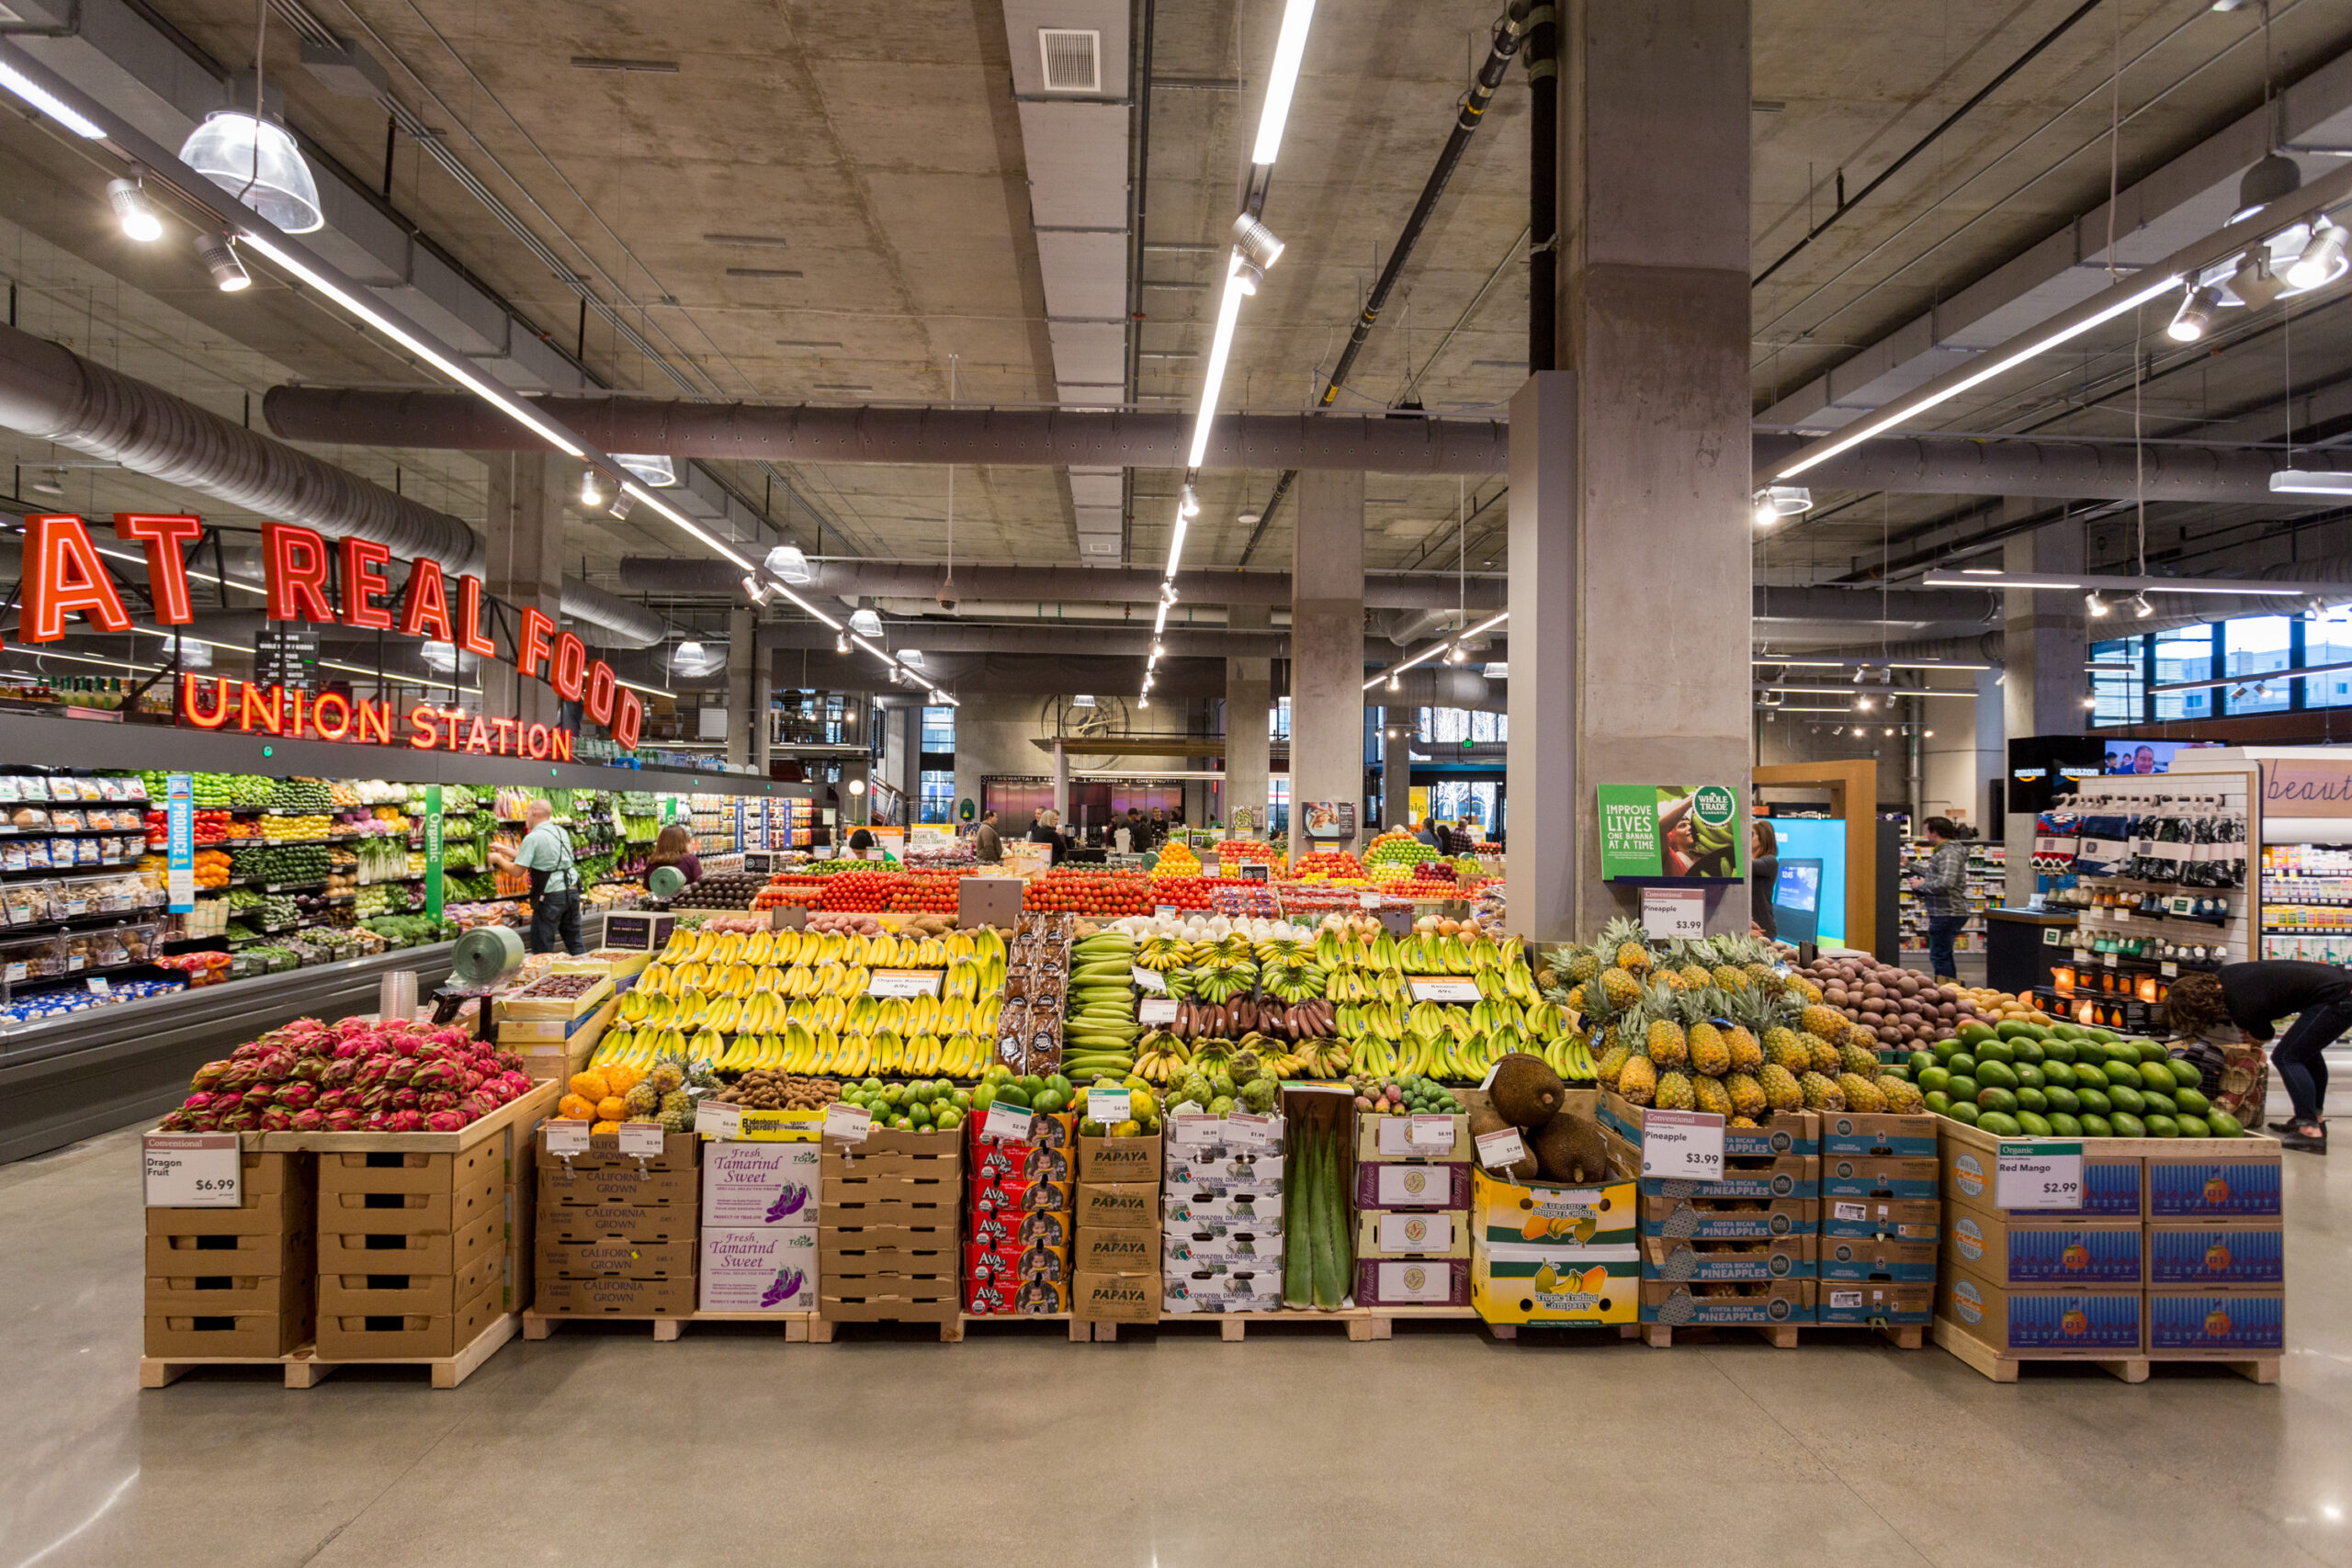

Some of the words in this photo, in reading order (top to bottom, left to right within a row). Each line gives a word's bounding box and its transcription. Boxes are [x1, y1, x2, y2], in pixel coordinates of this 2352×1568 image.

[0, 513, 203, 645] AT
[261, 522, 495, 658] REAL
[518, 606, 641, 750] FOOD
[185, 672, 390, 744] UNION
[411, 705, 571, 761] STATION
[2014, 768, 2046, 777] amazon
[2060, 768, 2099, 777] amazon
[1698, 793, 1727, 804] WHOLE
[1409, 802, 1425, 813] ale
[1606, 805, 1652, 815] IMPROVE
[173, 803, 187, 855] PRODUCE
[1607, 816, 1652, 832] LIVES
[427, 813, 441, 863] Organic
[1609, 840, 1619, 850] AT
[1623, 840, 1631, 850] A
[1634, 840, 1655, 851] TIME
[1645, 890, 1683, 898] Conventional
[1644, 904, 1677, 913] Pineapple
[1676, 920, 1702, 930] $3.99
[1647, 1113, 1695, 1124] Conventional
[1645, 1132, 1688, 1143] Pineapple
[148, 1139, 203, 1147] Conventional
[731, 1147, 761, 1159] Fresh
[1506, 1145, 1521, 1154] $1.99
[1724, 1145, 1769, 1154] EAPPLES
[2002, 1146, 2034, 1155] Organic
[593, 1152, 633, 1160] GROWN
[793, 1154, 811, 1164] Top
[1094, 1151, 1148, 1162] PAPAYA
[1686, 1153, 1719, 1165] $3.99
[147, 1158, 182, 1169] Dragon
[714, 1156, 783, 1170] Tamarind
[147, 1168, 169, 1177] Fruit
[1999, 1164, 2017, 1172] Red
[2019, 1164, 2051, 1173] Mango
[724, 1171, 767, 1183] Sweet
[196, 1179, 234, 1190] $6.99
[596, 1184, 637, 1193] GROWN
[2043, 1182, 2077, 1193] $2.99
[1702, 1186, 1770, 1195] PINEAPPLES
[1091, 1198, 1145, 1209] PAPAYA
[1542, 1202, 1589, 1212] Company
[584, 1209, 647, 1218] CALIFORNIA
[1532, 1209, 1566, 1219] Trading
[1568, 1209, 1597, 1219] Tropic
[594, 1220, 636, 1229] GROWN
[1702, 1227, 1768, 1236] PINEAPPLES
[726, 1232, 755, 1244] Fresh
[788, 1239, 807, 1247] Top
[709, 1240, 778, 1254] Tamarind
[1092, 1243, 1146, 1253] PAPAYA
[591, 1260, 632, 1269] GROWN
[720, 1255, 763, 1268] Sweet
[1701, 1269, 1768, 1279] PINEAPPLES
[583, 1281, 644, 1291] CALIFORNIA
[594, 1293, 634, 1303] GROWN
[1091, 1289, 1146, 1301] PAPAYA
[1535, 1292, 1563, 1303] Tropic
[1564, 1292, 1599, 1303] Trading
[1543, 1302, 1591, 1312] Company
[1699, 1313, 1766, 1322] PINEAPPLES
